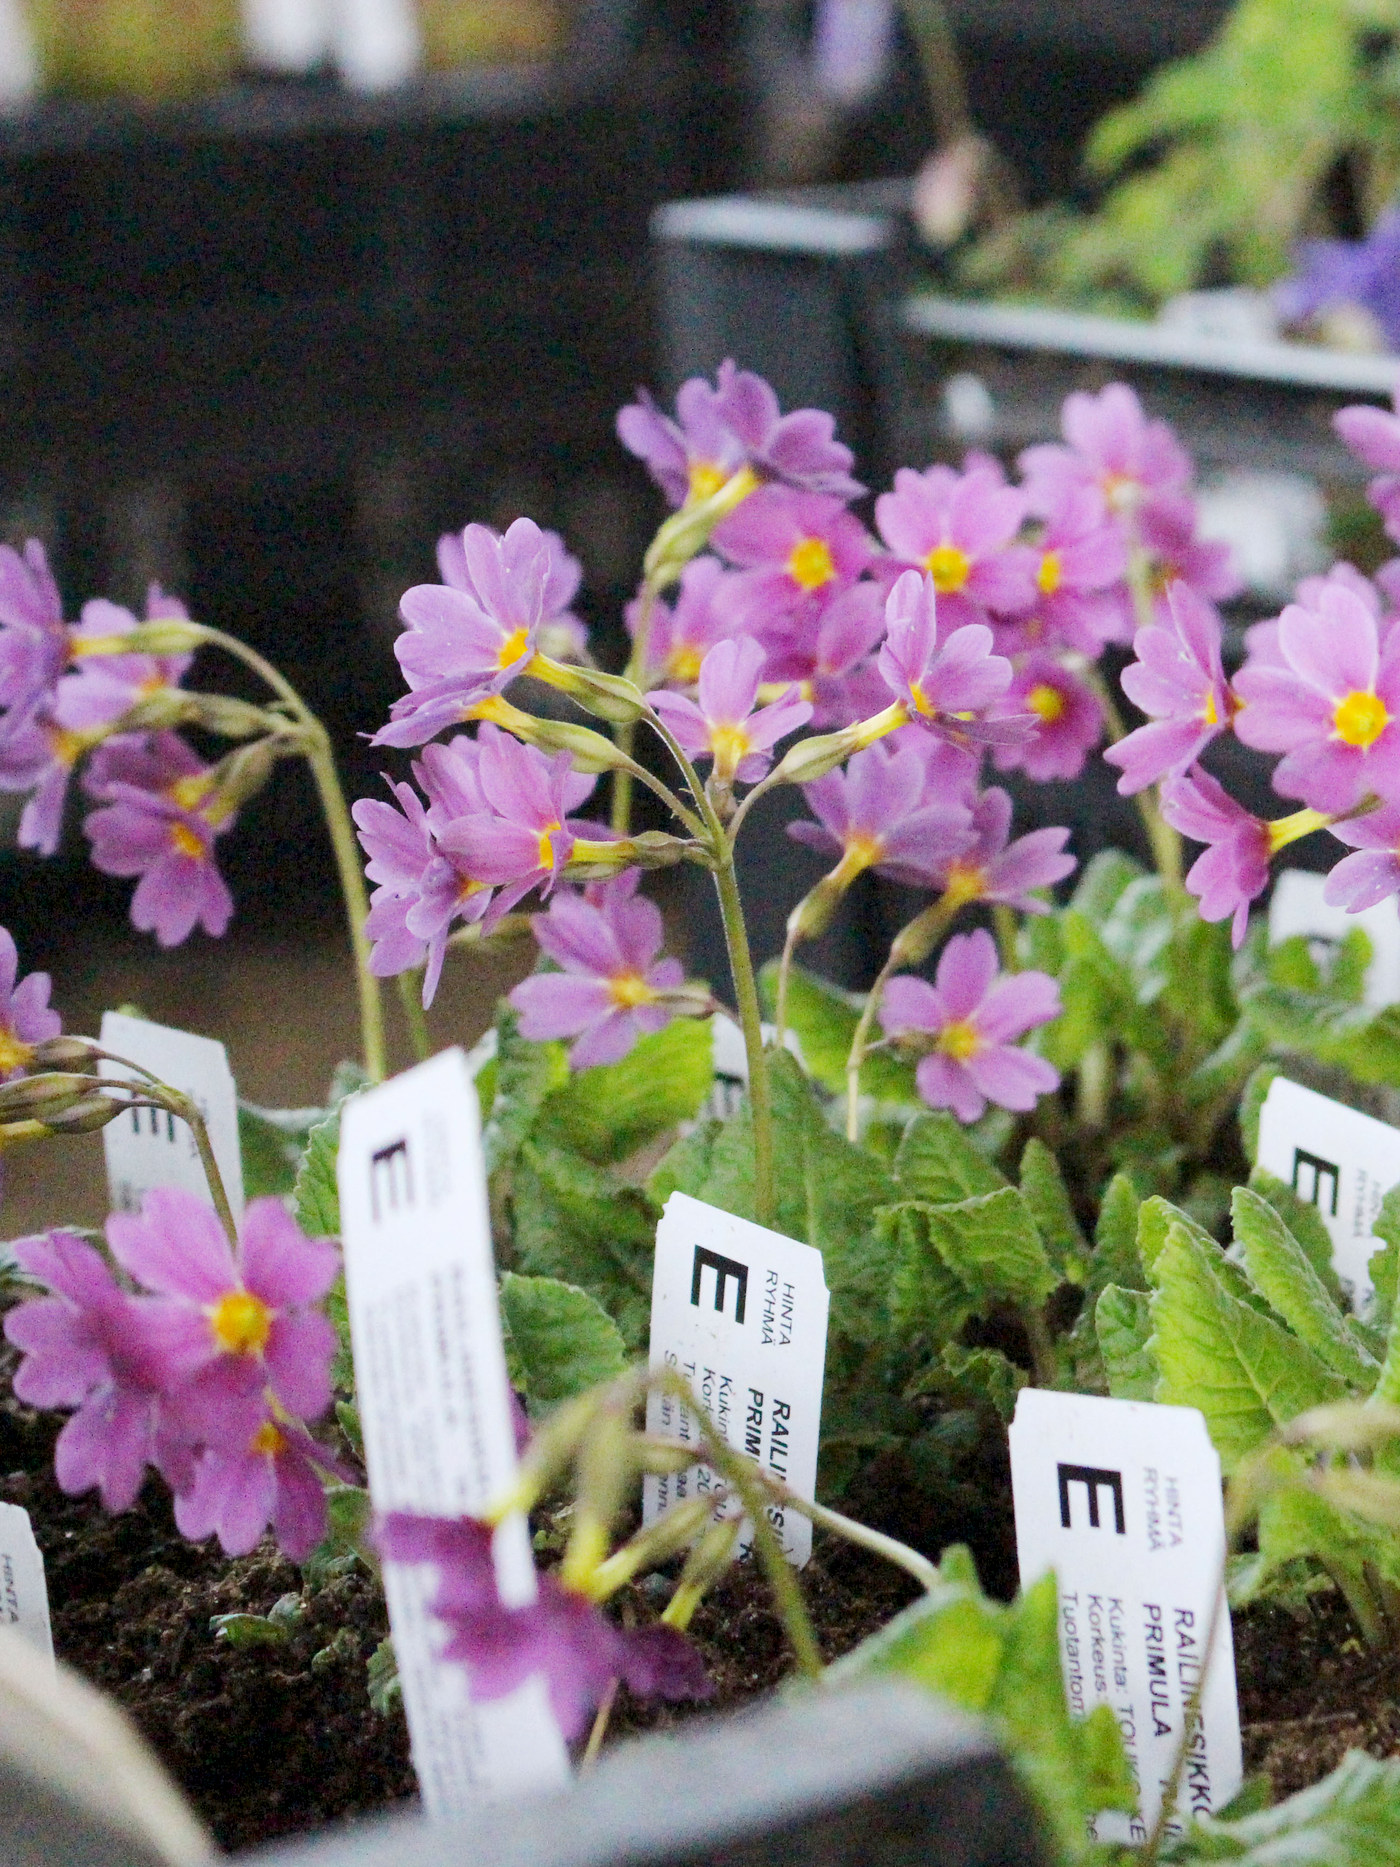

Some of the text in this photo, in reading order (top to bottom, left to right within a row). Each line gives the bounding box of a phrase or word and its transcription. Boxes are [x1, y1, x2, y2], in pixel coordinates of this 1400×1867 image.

[1292, 1147, 1339, 1217] E
[690, 1244, 749, 1325] E
[760, 1268, 778, 1346] RYHMÄ
[778, 1282, 795, 1346] HINTA
[1057, 1462, 1127, 1535] E
[1143, 1466, 1167, 1552] RYHMÄ
[1164, 1475, 1185, 1549] HINTA
[1107, 1597, 1130, 1695] Kukinta:
[1142, 1603, 1173, 1738] PRIMULA
